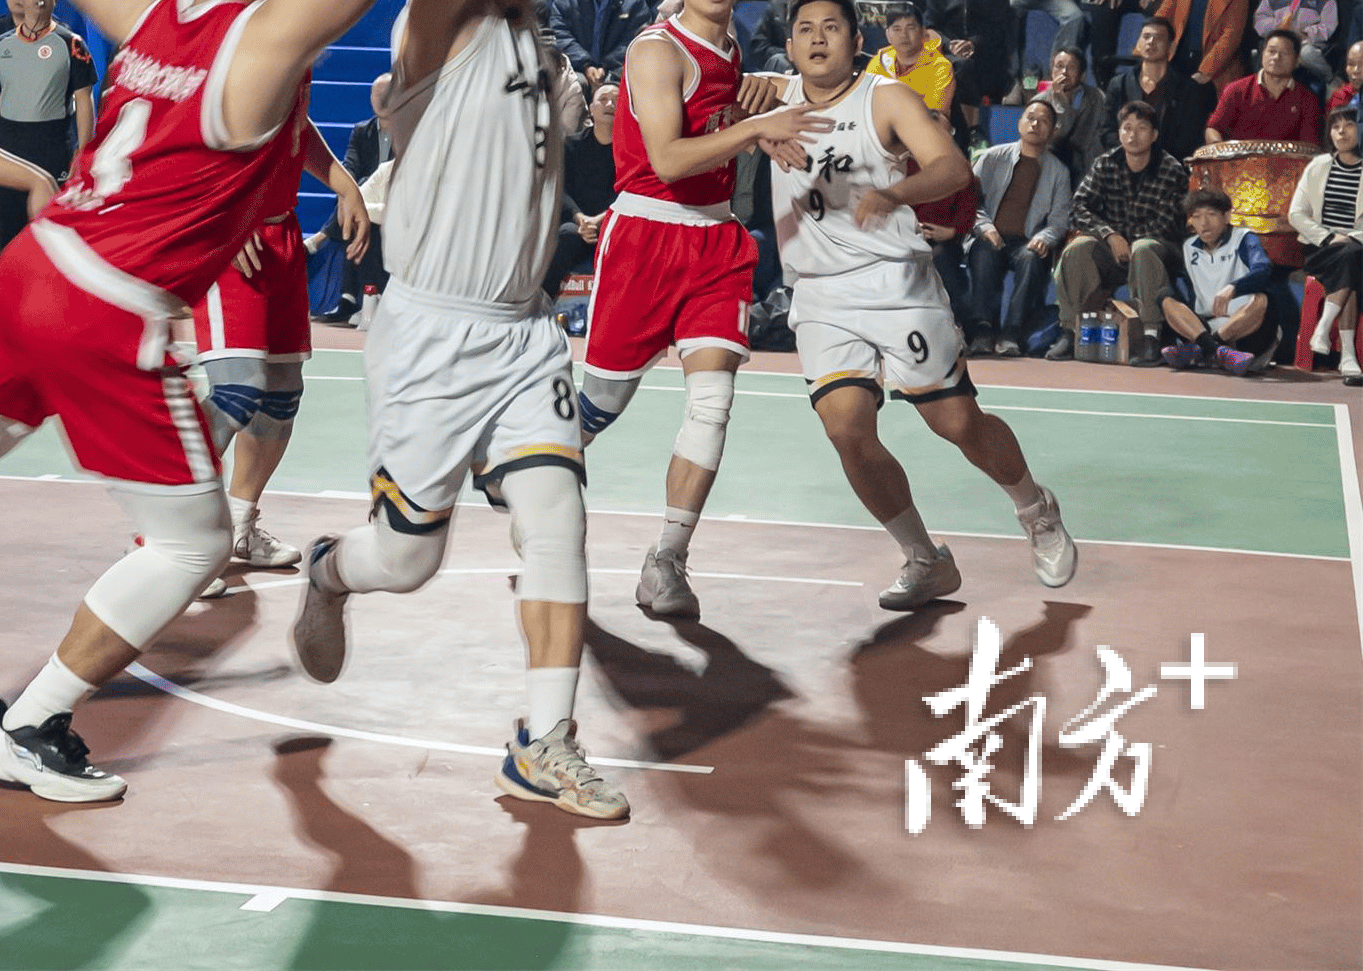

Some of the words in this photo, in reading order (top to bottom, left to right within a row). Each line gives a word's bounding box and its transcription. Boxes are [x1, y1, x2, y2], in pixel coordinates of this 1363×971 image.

[809, 188, 825, 222] 9
[907, 330, 929, 364] 9
[552, 376, 575, 421] 8
